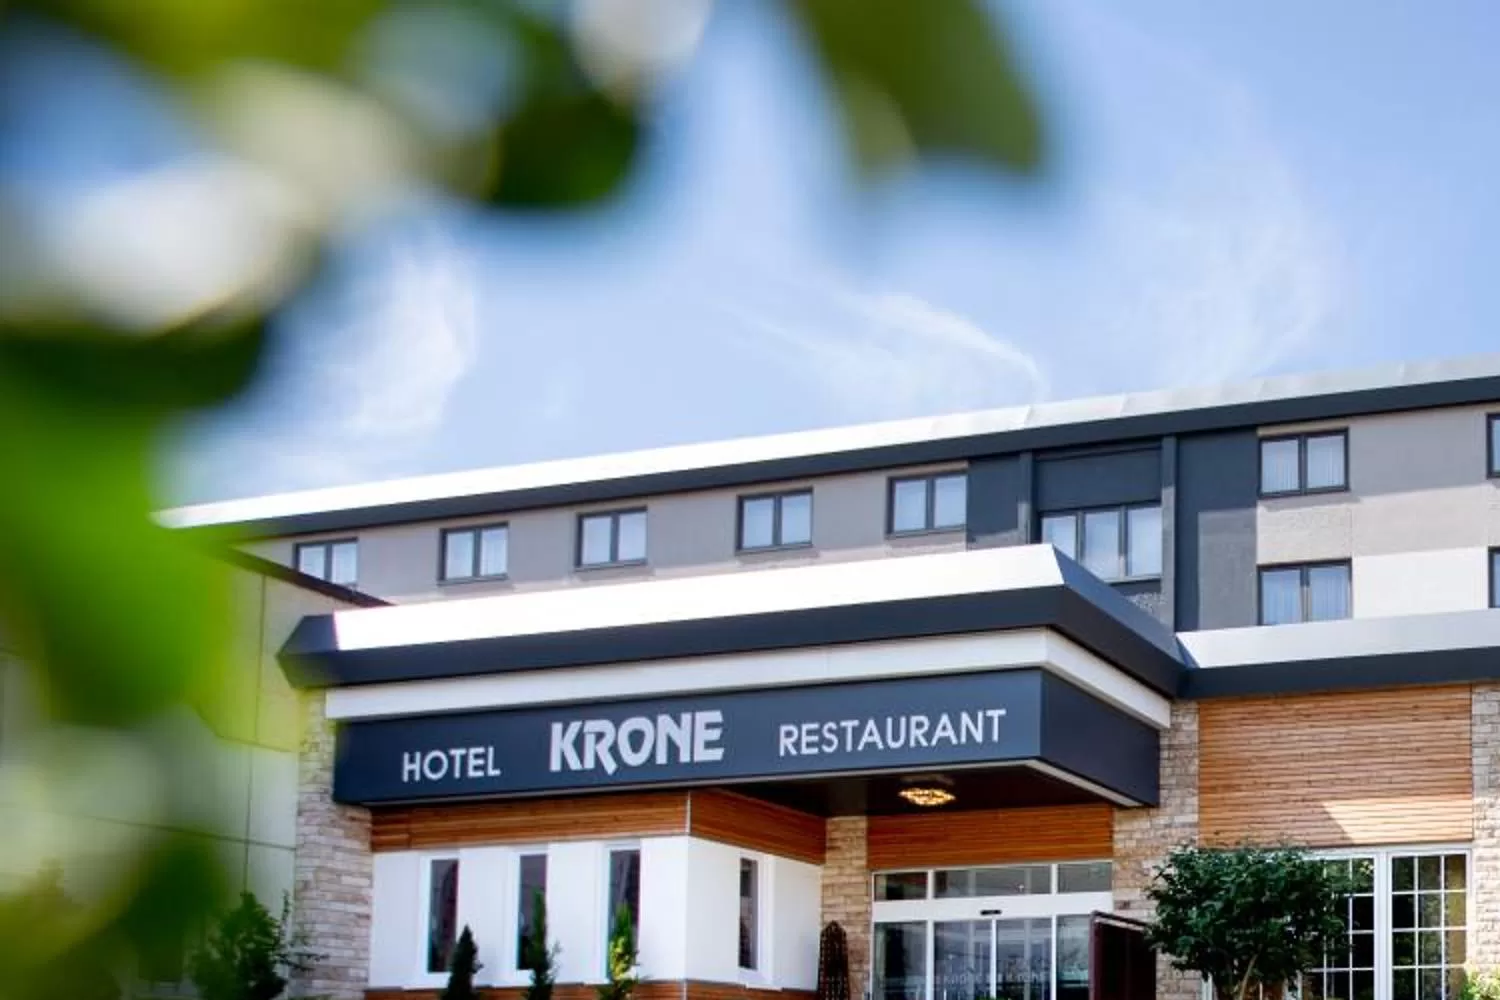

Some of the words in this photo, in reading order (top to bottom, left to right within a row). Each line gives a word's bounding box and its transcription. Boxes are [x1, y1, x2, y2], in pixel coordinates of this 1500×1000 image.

[402, 746, 501, 783] HOTEL
[549, 709, 725, 776] KRONE
[779, 708, 1007, 757] RESTAURANT
